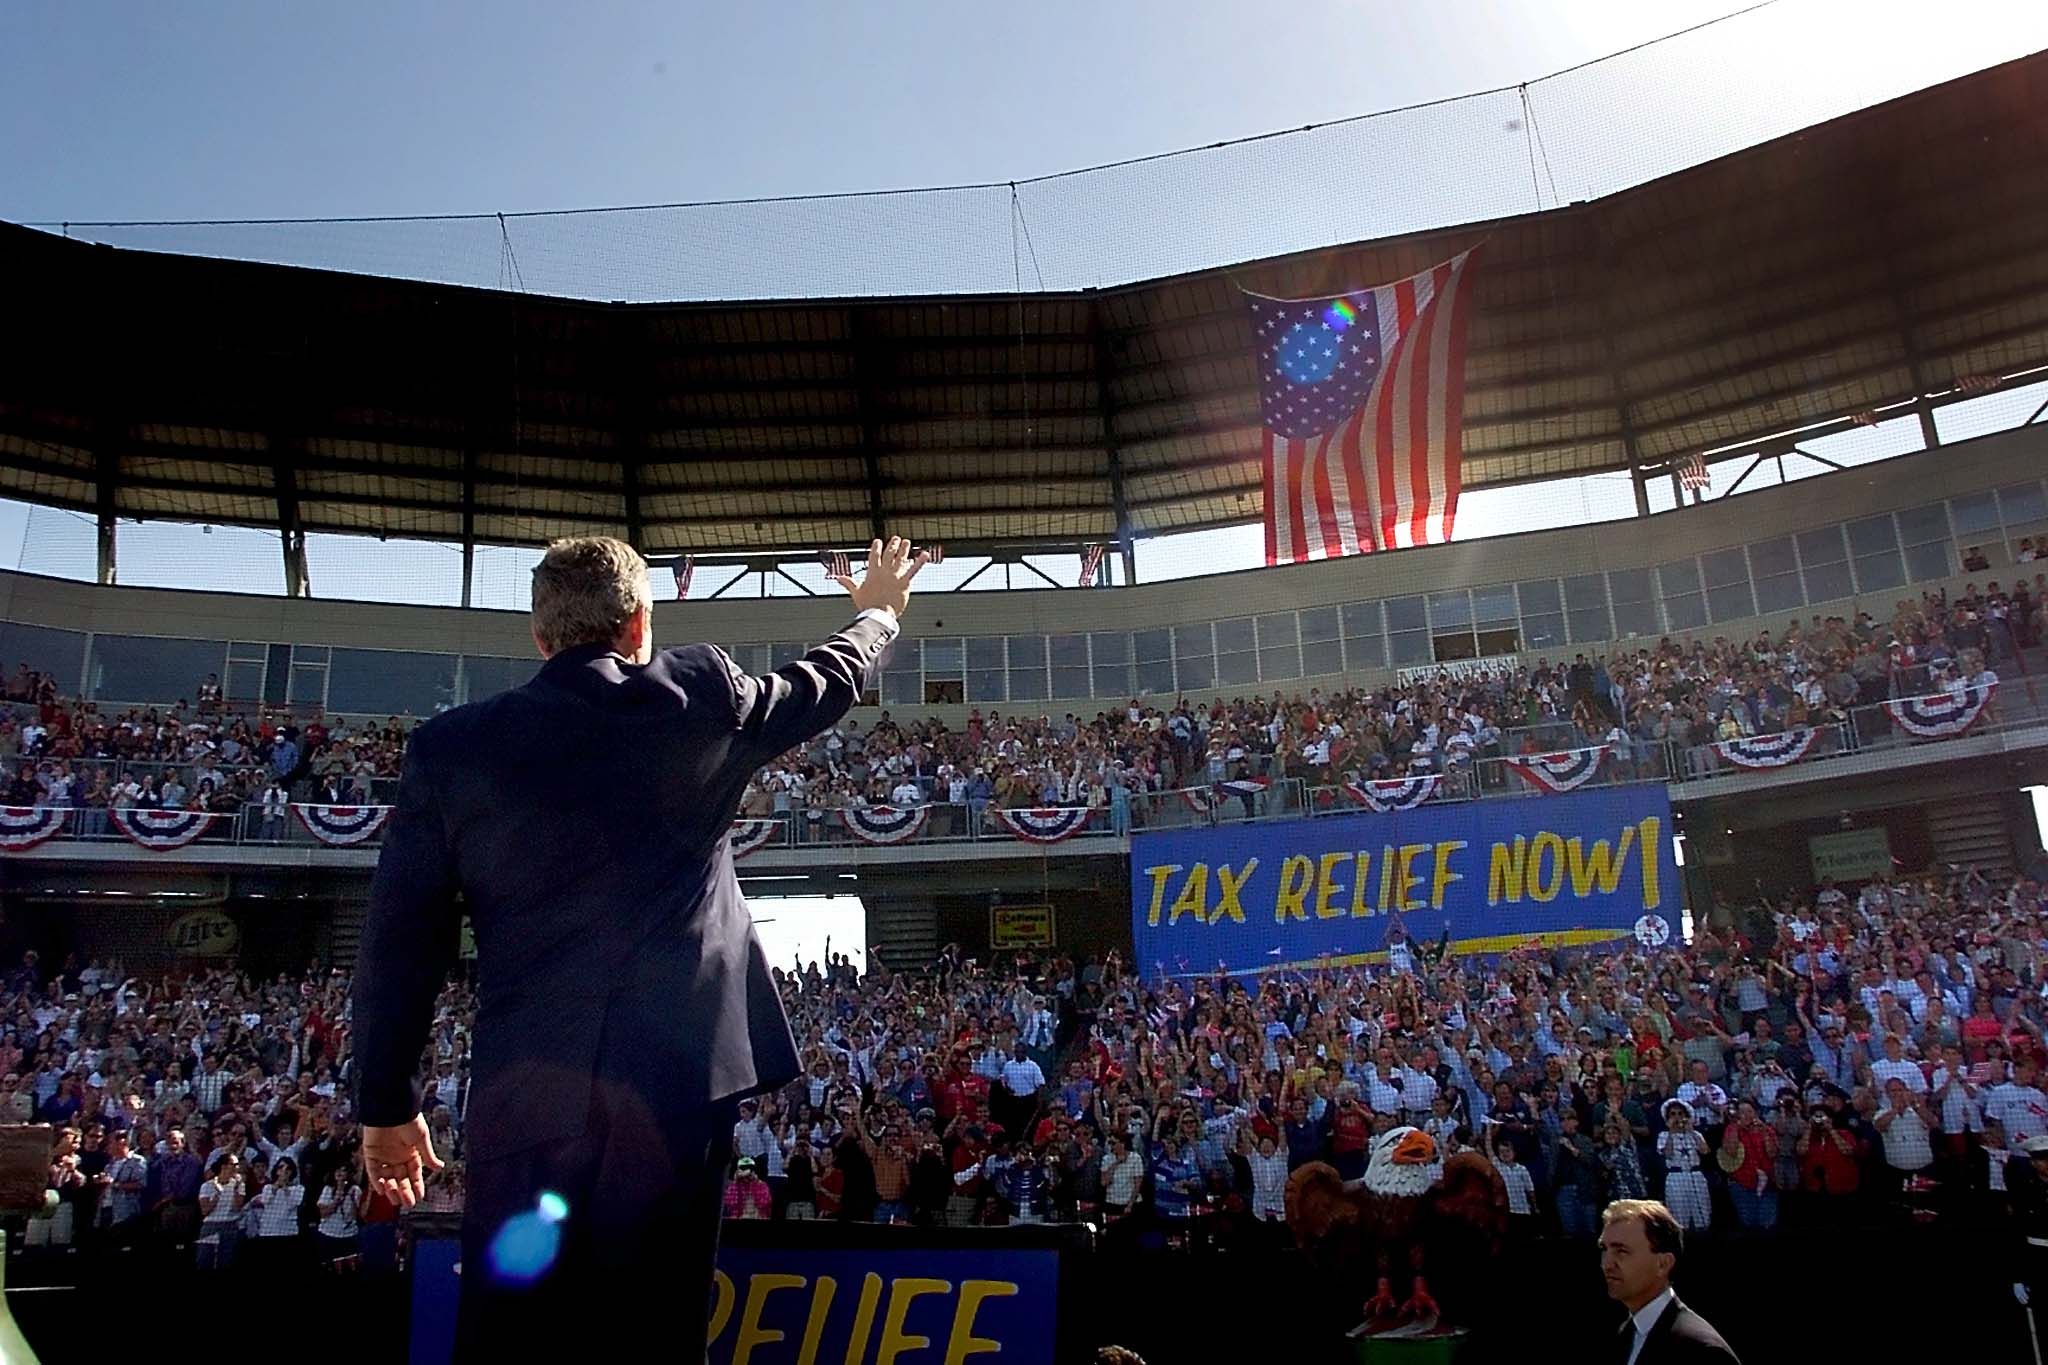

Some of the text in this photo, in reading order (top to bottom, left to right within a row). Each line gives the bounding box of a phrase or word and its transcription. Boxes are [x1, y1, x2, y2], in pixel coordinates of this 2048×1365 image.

[1144, 815, 1662, 927] TAX RELIEF NOW!
